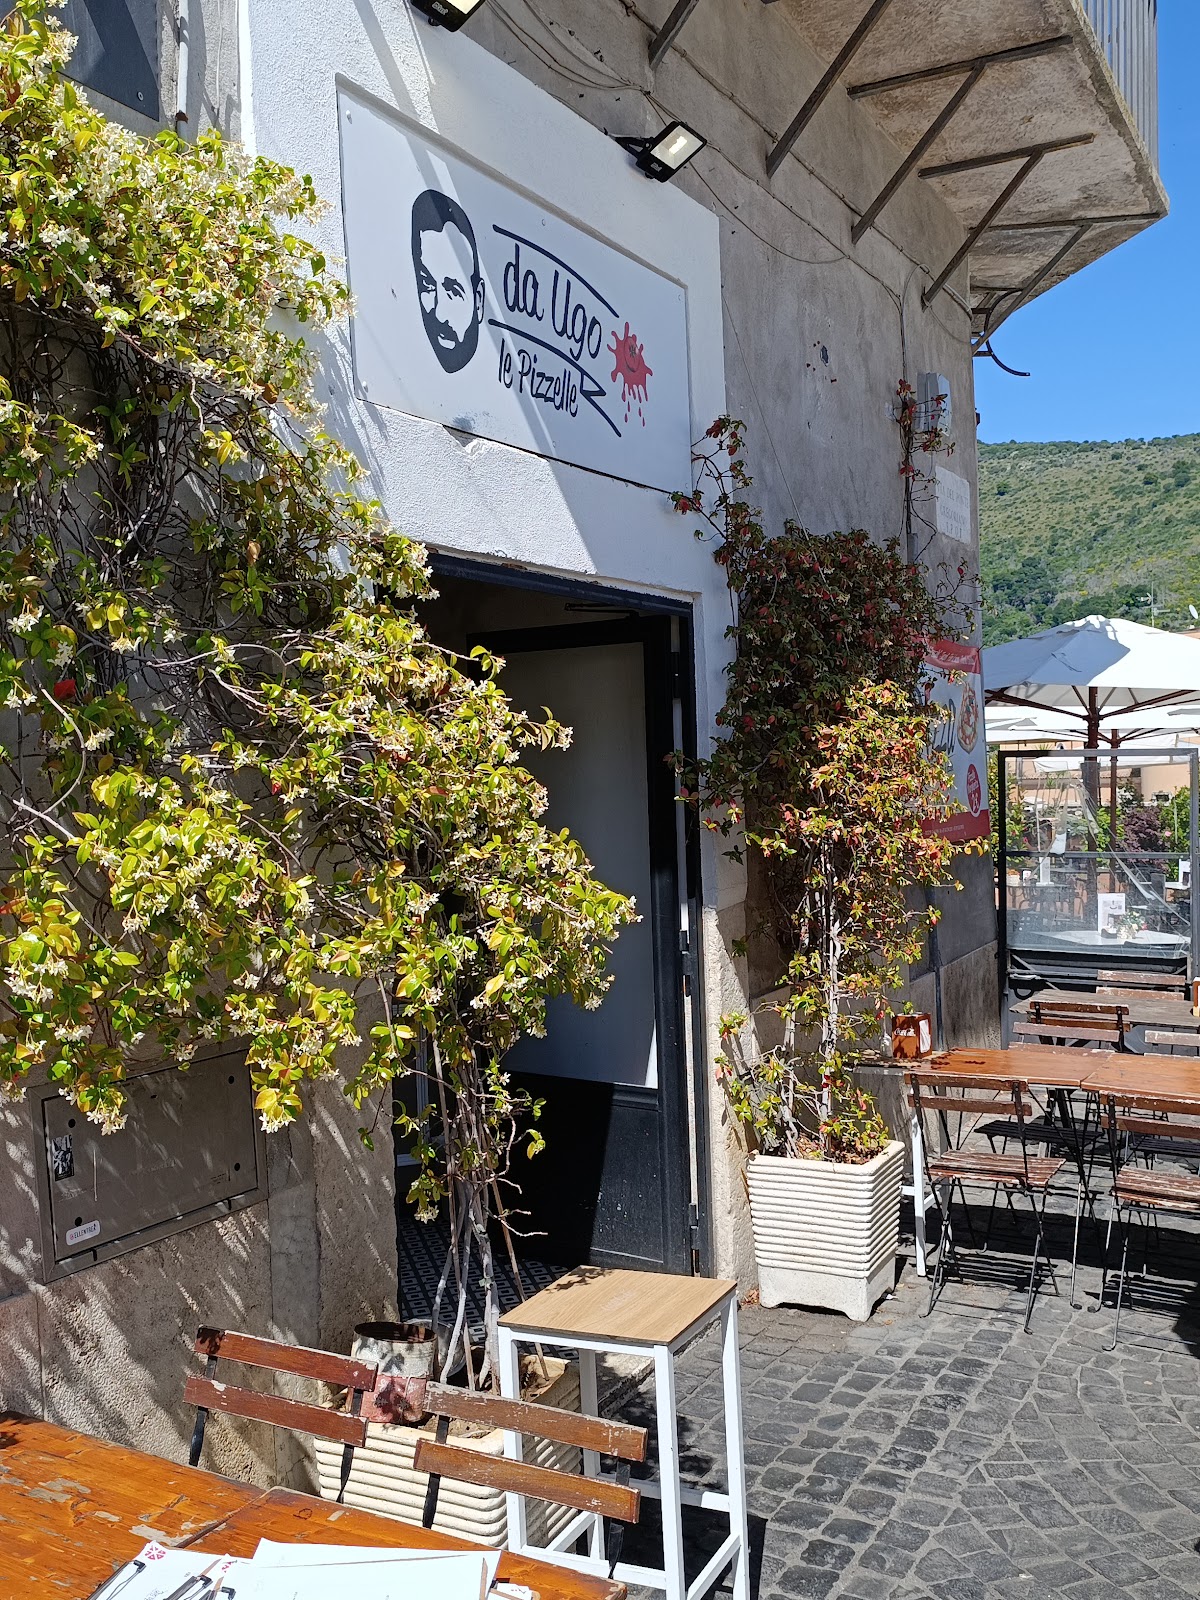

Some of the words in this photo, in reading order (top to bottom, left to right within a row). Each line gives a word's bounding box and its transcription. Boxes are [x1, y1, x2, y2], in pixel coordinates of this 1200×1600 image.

[503, 242, 545, 321] da
[551, 269, 602, 361] Ugo
[498, 338, 513, 389] le
[517, 348, 578, 418] Pizzelle
